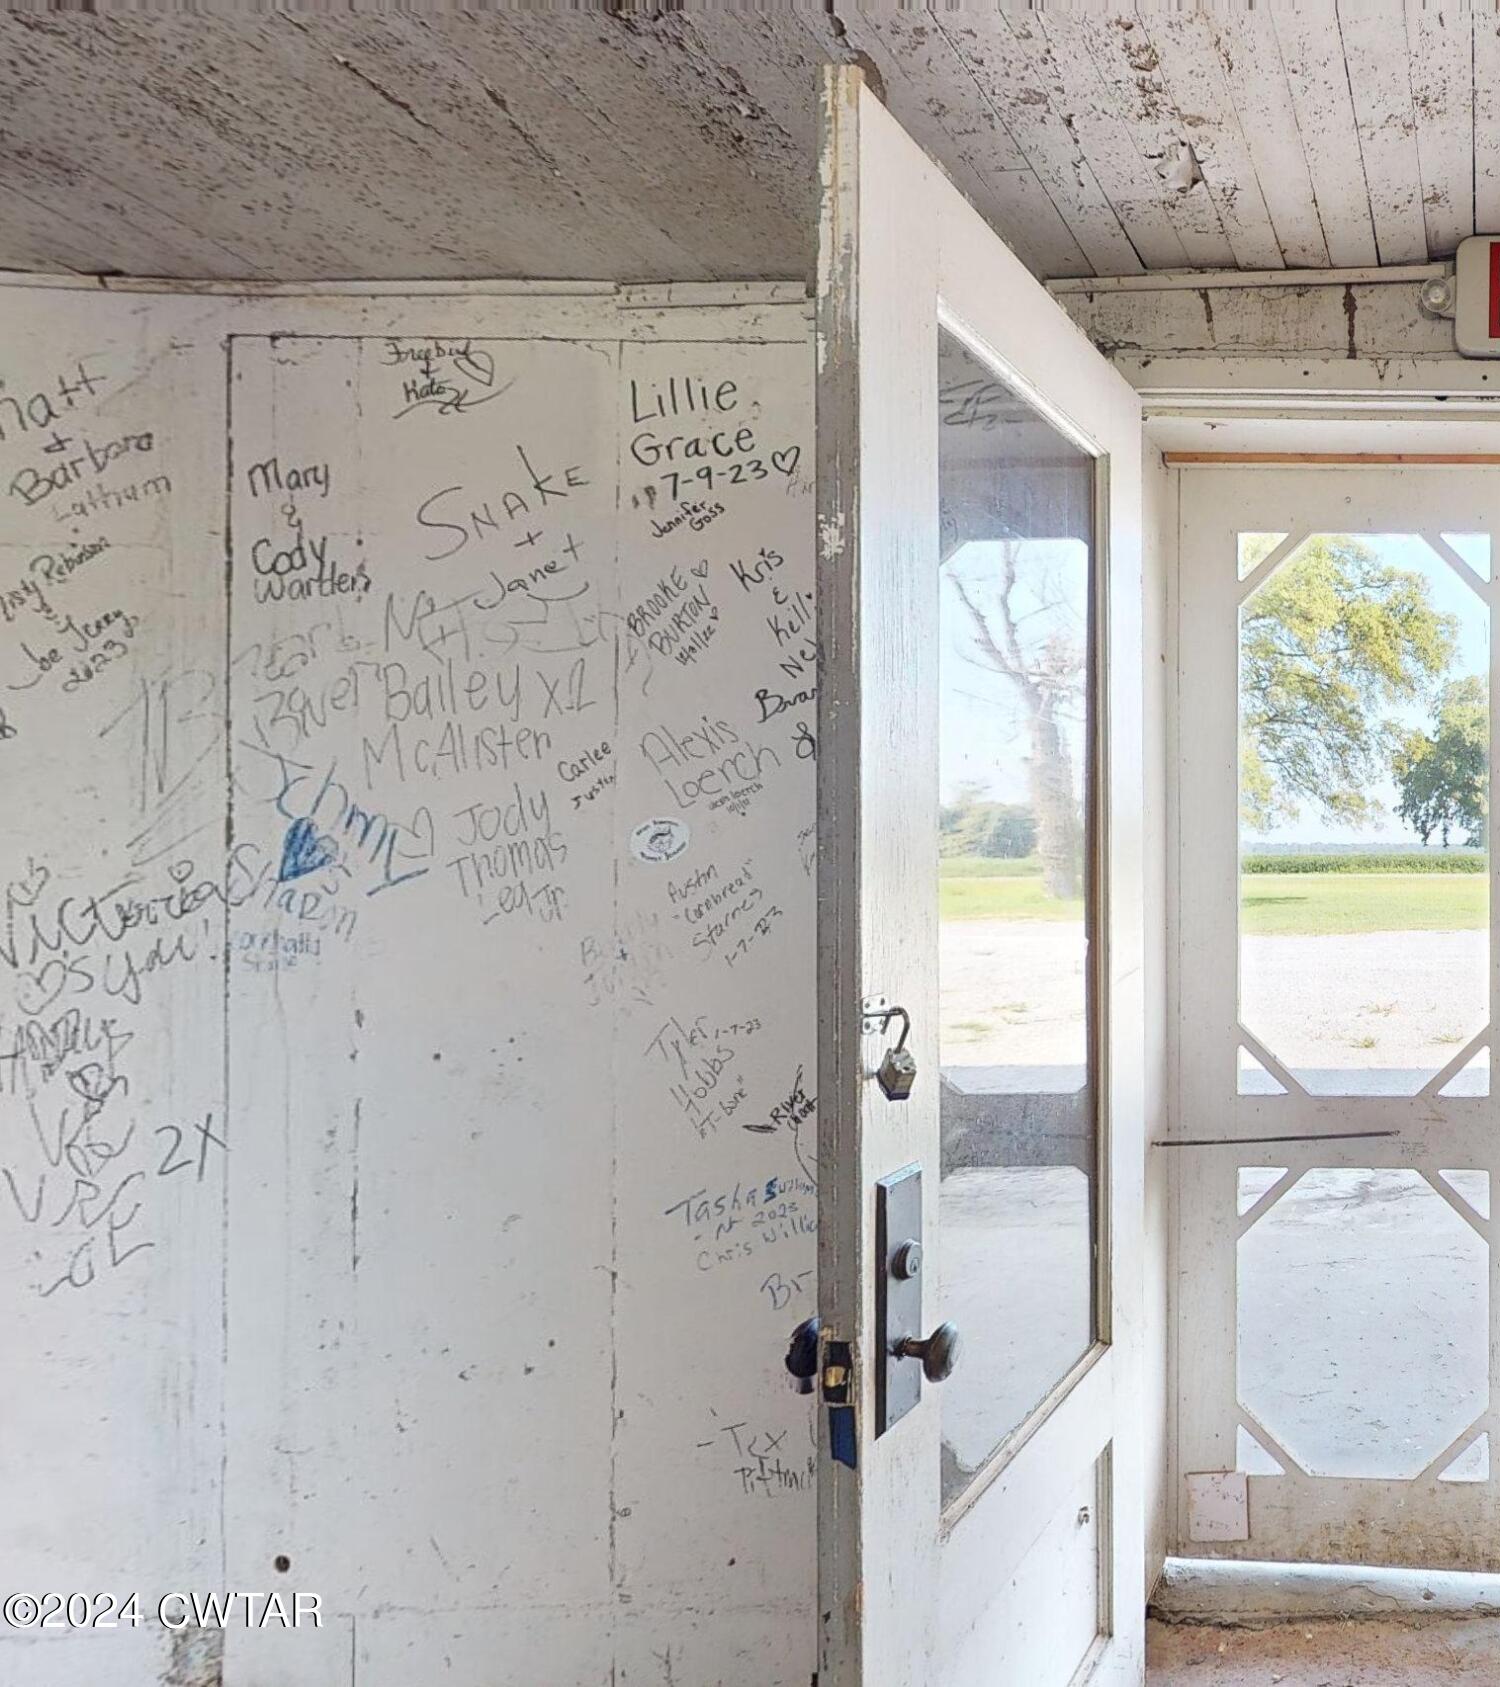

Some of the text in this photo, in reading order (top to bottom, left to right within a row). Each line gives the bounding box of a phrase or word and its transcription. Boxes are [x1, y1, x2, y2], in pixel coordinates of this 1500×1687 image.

[631, 377, 737, 423] Lillie
[630, 427, 756, 466] Grace
[247, 457, 330, 498] Mary
[660, 460, 768, 501] 7-9-23
[416, 445, 591, 561] SNAKE
[651, 500, 708, 538] Jennifer
[688, 502, 726, 532] Goss
[252, 519, 328, 579] Cody
[473, 533, 587, 610] Janet
[728, 547, 785, 593] Kris
[626, 565, 688, 638] BROOKE
[648, 583, 712, 656] BURTON
[558, 741, 612, 783] Carlee
[640, 715, 740, 776] Alexis
[664, 743, 782, 809] Loerch
[667, 863, 718, 903] Austin
